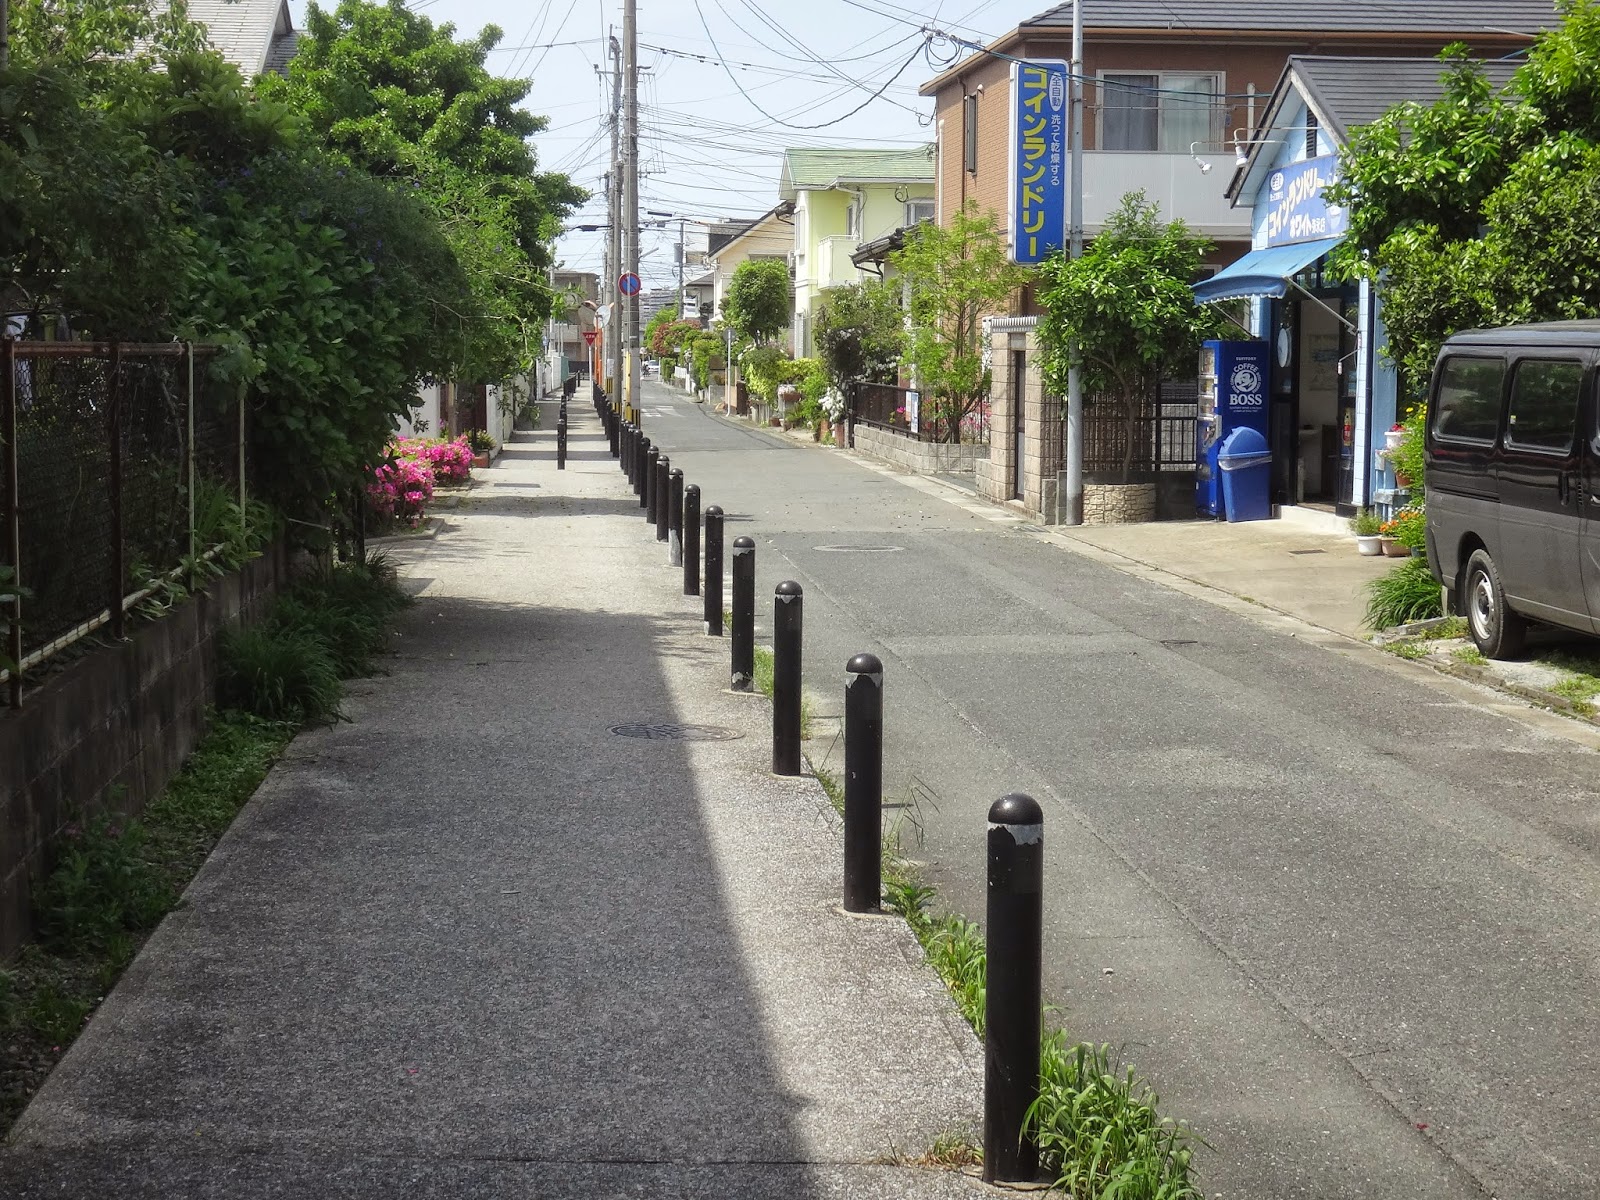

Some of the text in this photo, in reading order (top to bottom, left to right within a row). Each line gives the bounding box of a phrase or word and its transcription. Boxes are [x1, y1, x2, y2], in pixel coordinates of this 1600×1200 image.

[1022, 68, 1047, 257] コインランドリー
[1050, 74, 1062, 186] 全自動 洗って乾燥する
[1269, 167, 1325, 238] コインランドリー
[1229, 393, 1262, 405] BOSS
[1233, 362, 1259, 373] COFFEE
